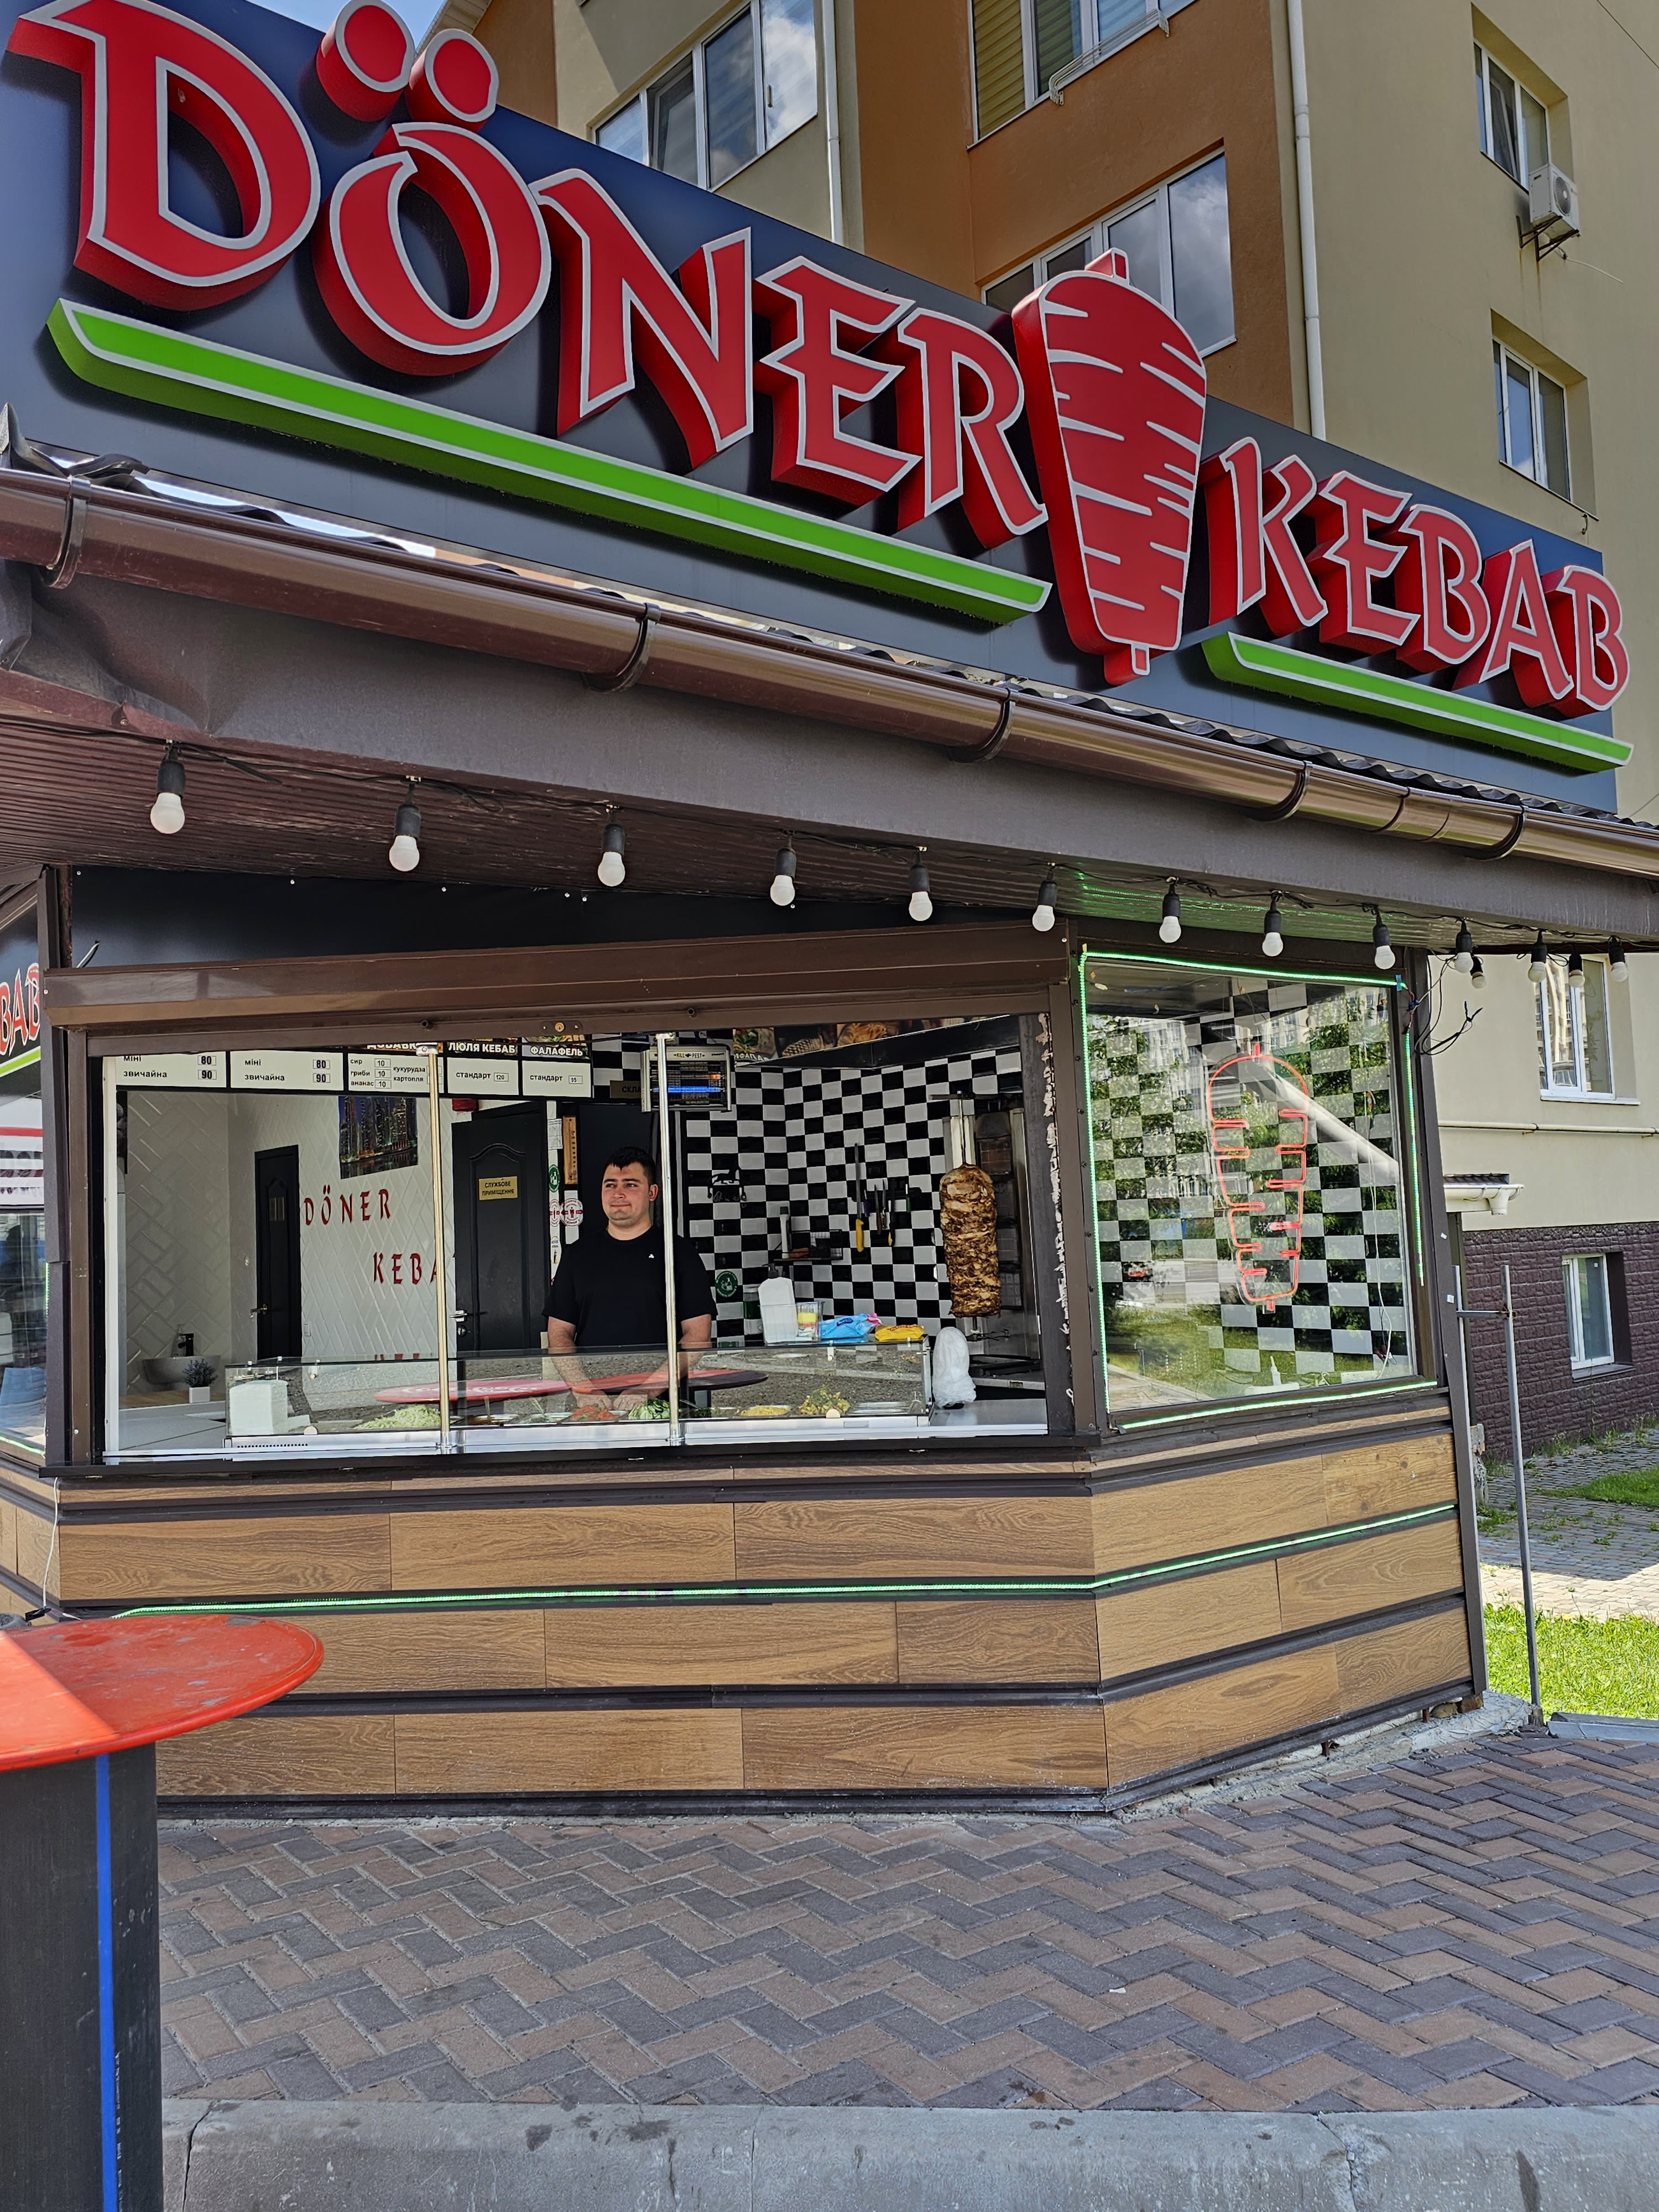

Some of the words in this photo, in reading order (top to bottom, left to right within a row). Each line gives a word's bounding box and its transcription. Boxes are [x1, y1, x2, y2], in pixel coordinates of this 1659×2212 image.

[7, 0, 1048, 549] DÖNER
[1199, 437, 1630, 717] KEBAB
[448, 1042, 480, 1052] ЛЮЛЯ
[482, 1044, 515, 1053] КЕБАБ
[531, 1046, 583, 1056] ФАЛАФЕЛЬ
[201, 1056, 212, 1065] 80
[316, 1060, 326, 1069] 80
[123, 1070, 167, 1078] звичайна
[201, 1070, 213, 1079] 90
[316, 1074, 326, 1083] 90
[304, 1184, 391, 1226] DÖNER
[373, 1251, 455, 1285] KEB
